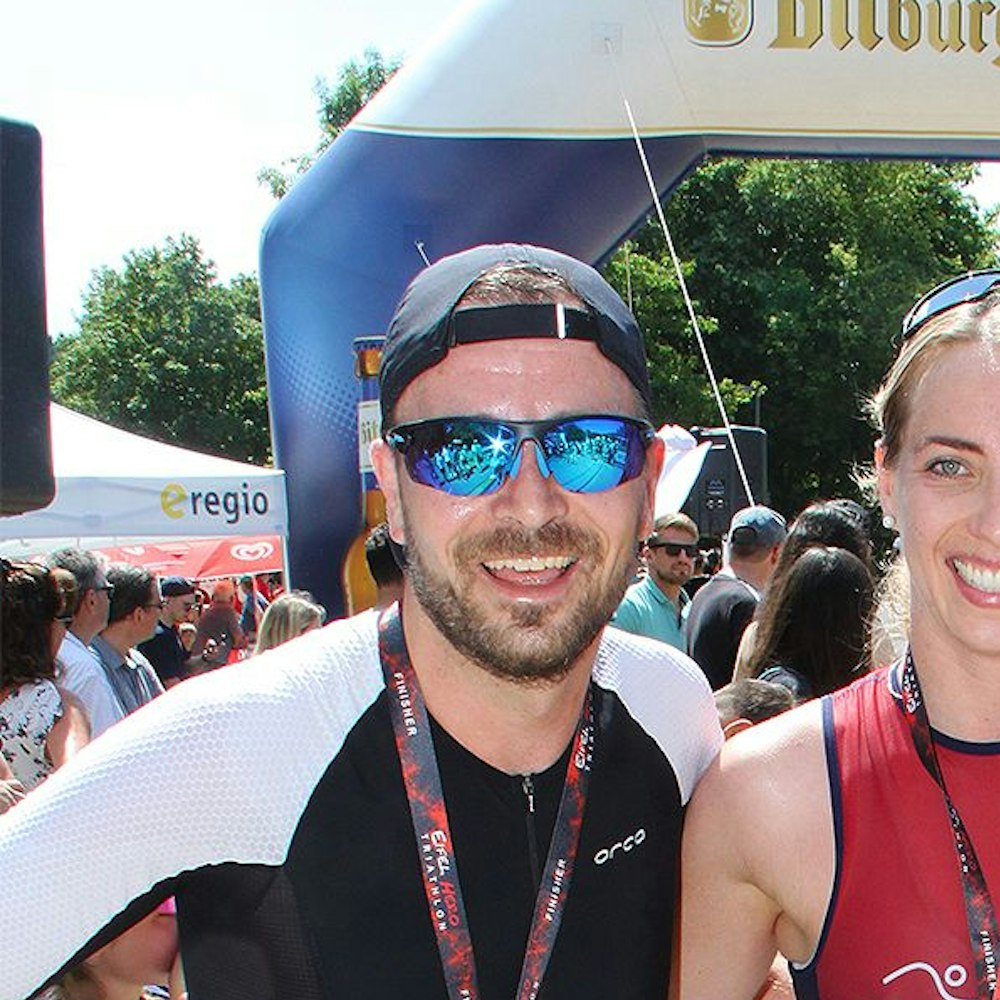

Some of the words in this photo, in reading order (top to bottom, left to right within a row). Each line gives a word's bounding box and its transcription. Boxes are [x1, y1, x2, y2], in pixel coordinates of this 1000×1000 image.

[394, 672, 417, 736] FINISHER
[420, 833, 448, 931] TRIATHLON
[431, 830, 450, 876] EIFEL
[544, 858, 566, 921] FINISHER
[980, 931, 997, 991] FINISHER
